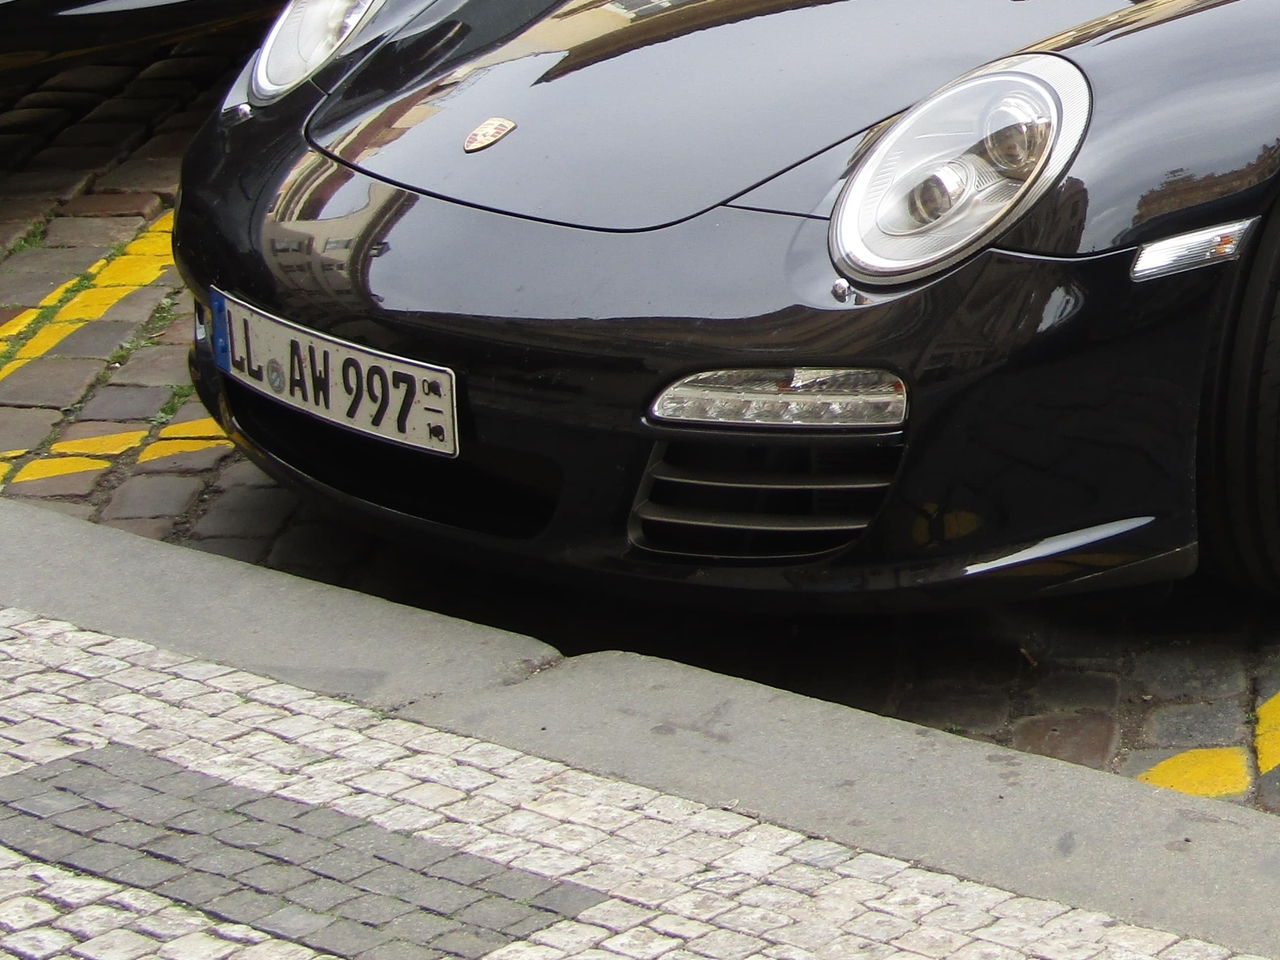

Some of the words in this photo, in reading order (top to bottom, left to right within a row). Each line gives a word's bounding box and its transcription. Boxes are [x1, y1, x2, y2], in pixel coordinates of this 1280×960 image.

[226, 309, 263, 382] LL
[290, 339, 331, 410] AW
[342, 357, 417, 434] 997
